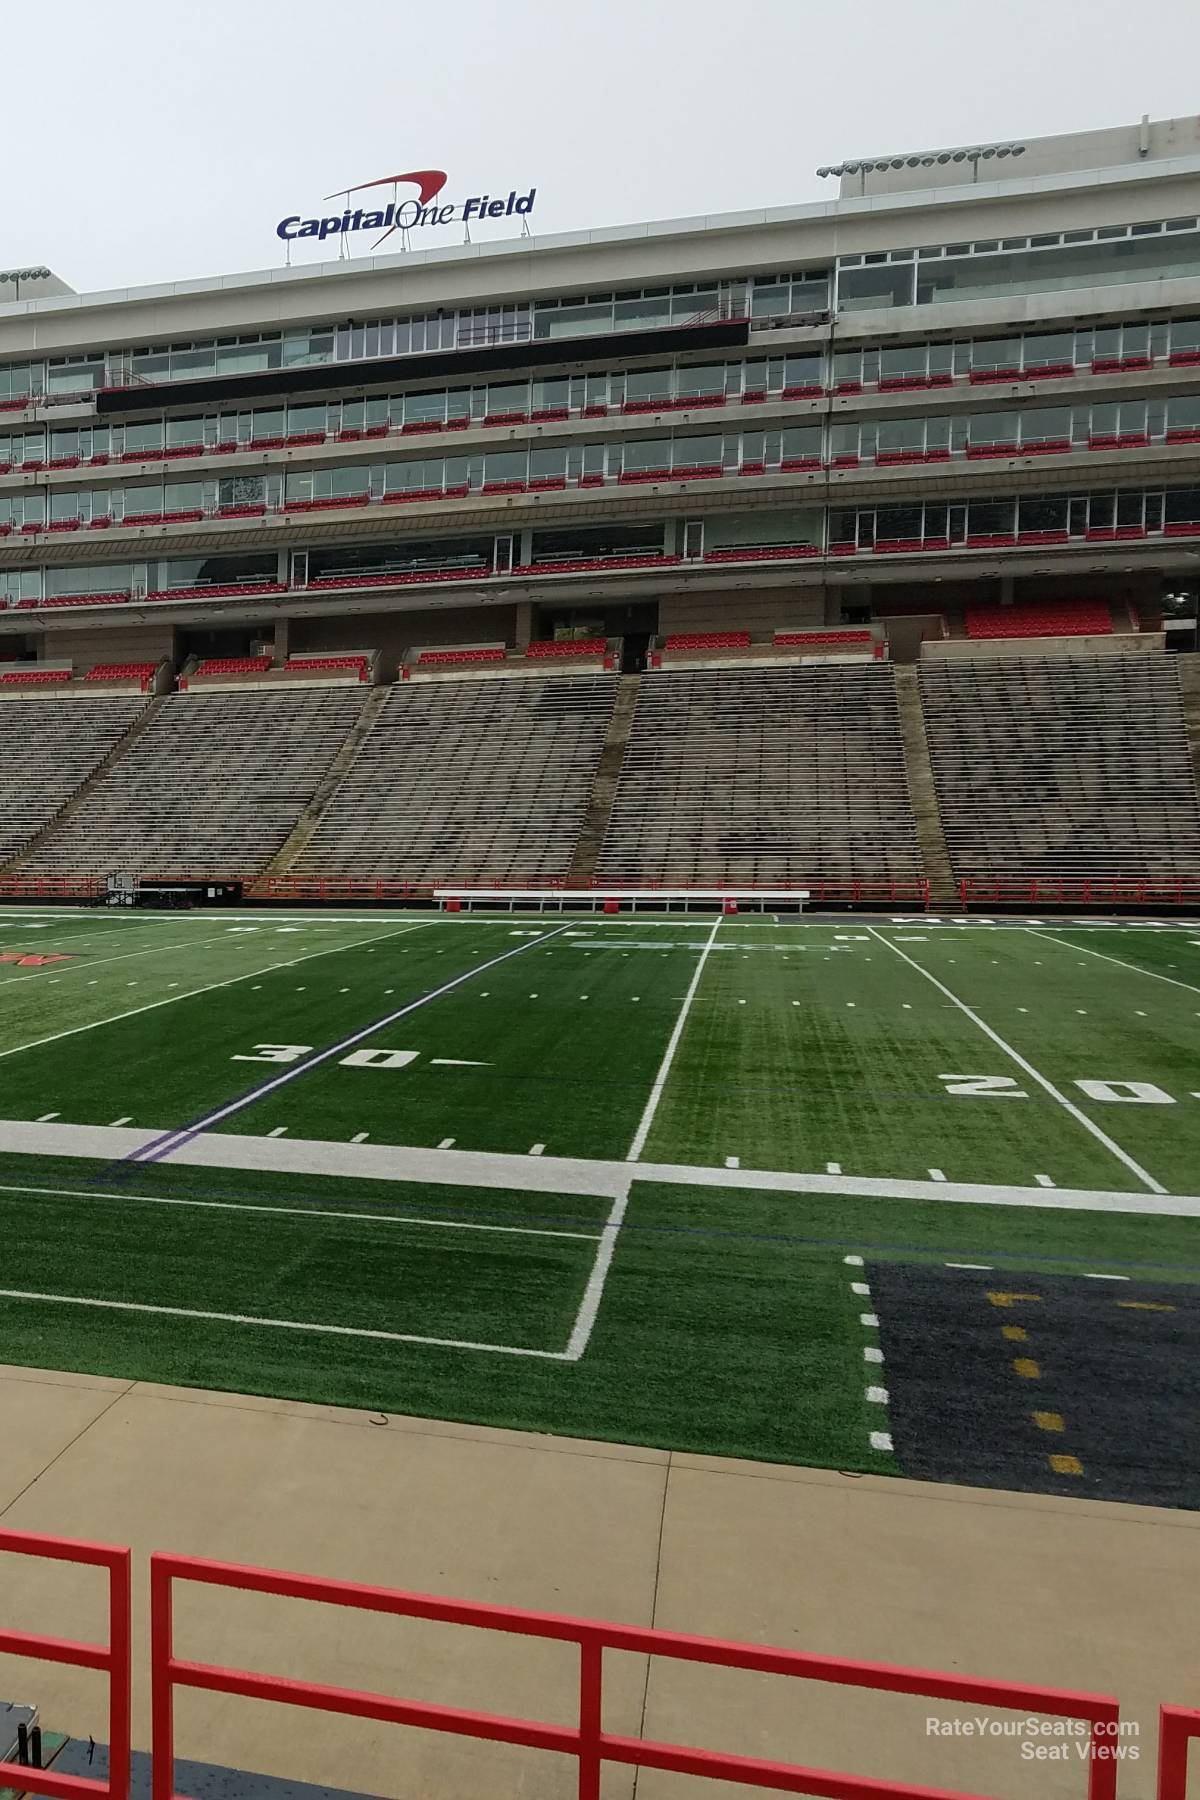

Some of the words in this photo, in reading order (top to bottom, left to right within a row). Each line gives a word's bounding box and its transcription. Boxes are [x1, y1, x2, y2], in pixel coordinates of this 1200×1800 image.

[461, 188, 537, 221] Field
[229, 1044, 422, 1068] 30
[937, 1074, 1178, 1104] 20
